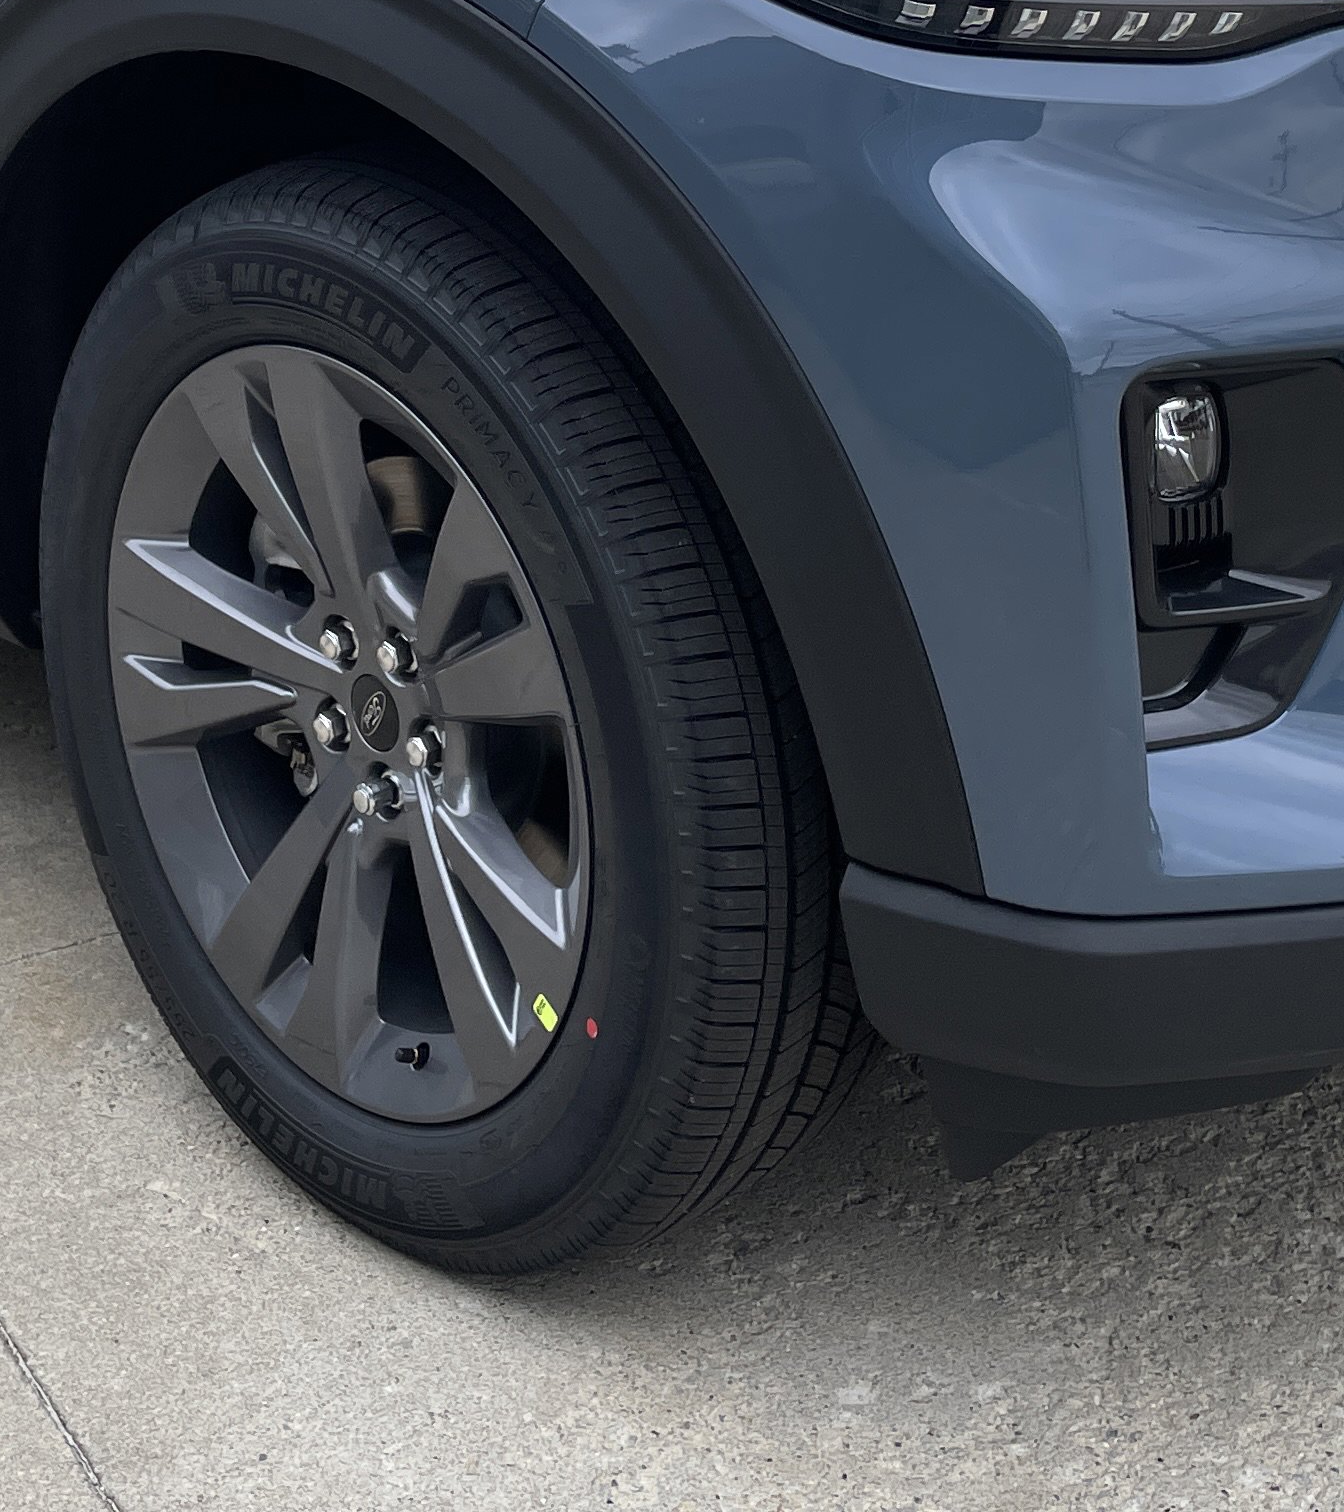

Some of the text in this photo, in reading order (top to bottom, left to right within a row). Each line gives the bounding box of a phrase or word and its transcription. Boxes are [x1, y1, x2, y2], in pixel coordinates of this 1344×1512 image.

[231, 261, 416, 360] MICHELIN
[440, 375, 539, 511] PRIMACY
[216, 1069, 390, 1211] MICHELIN
